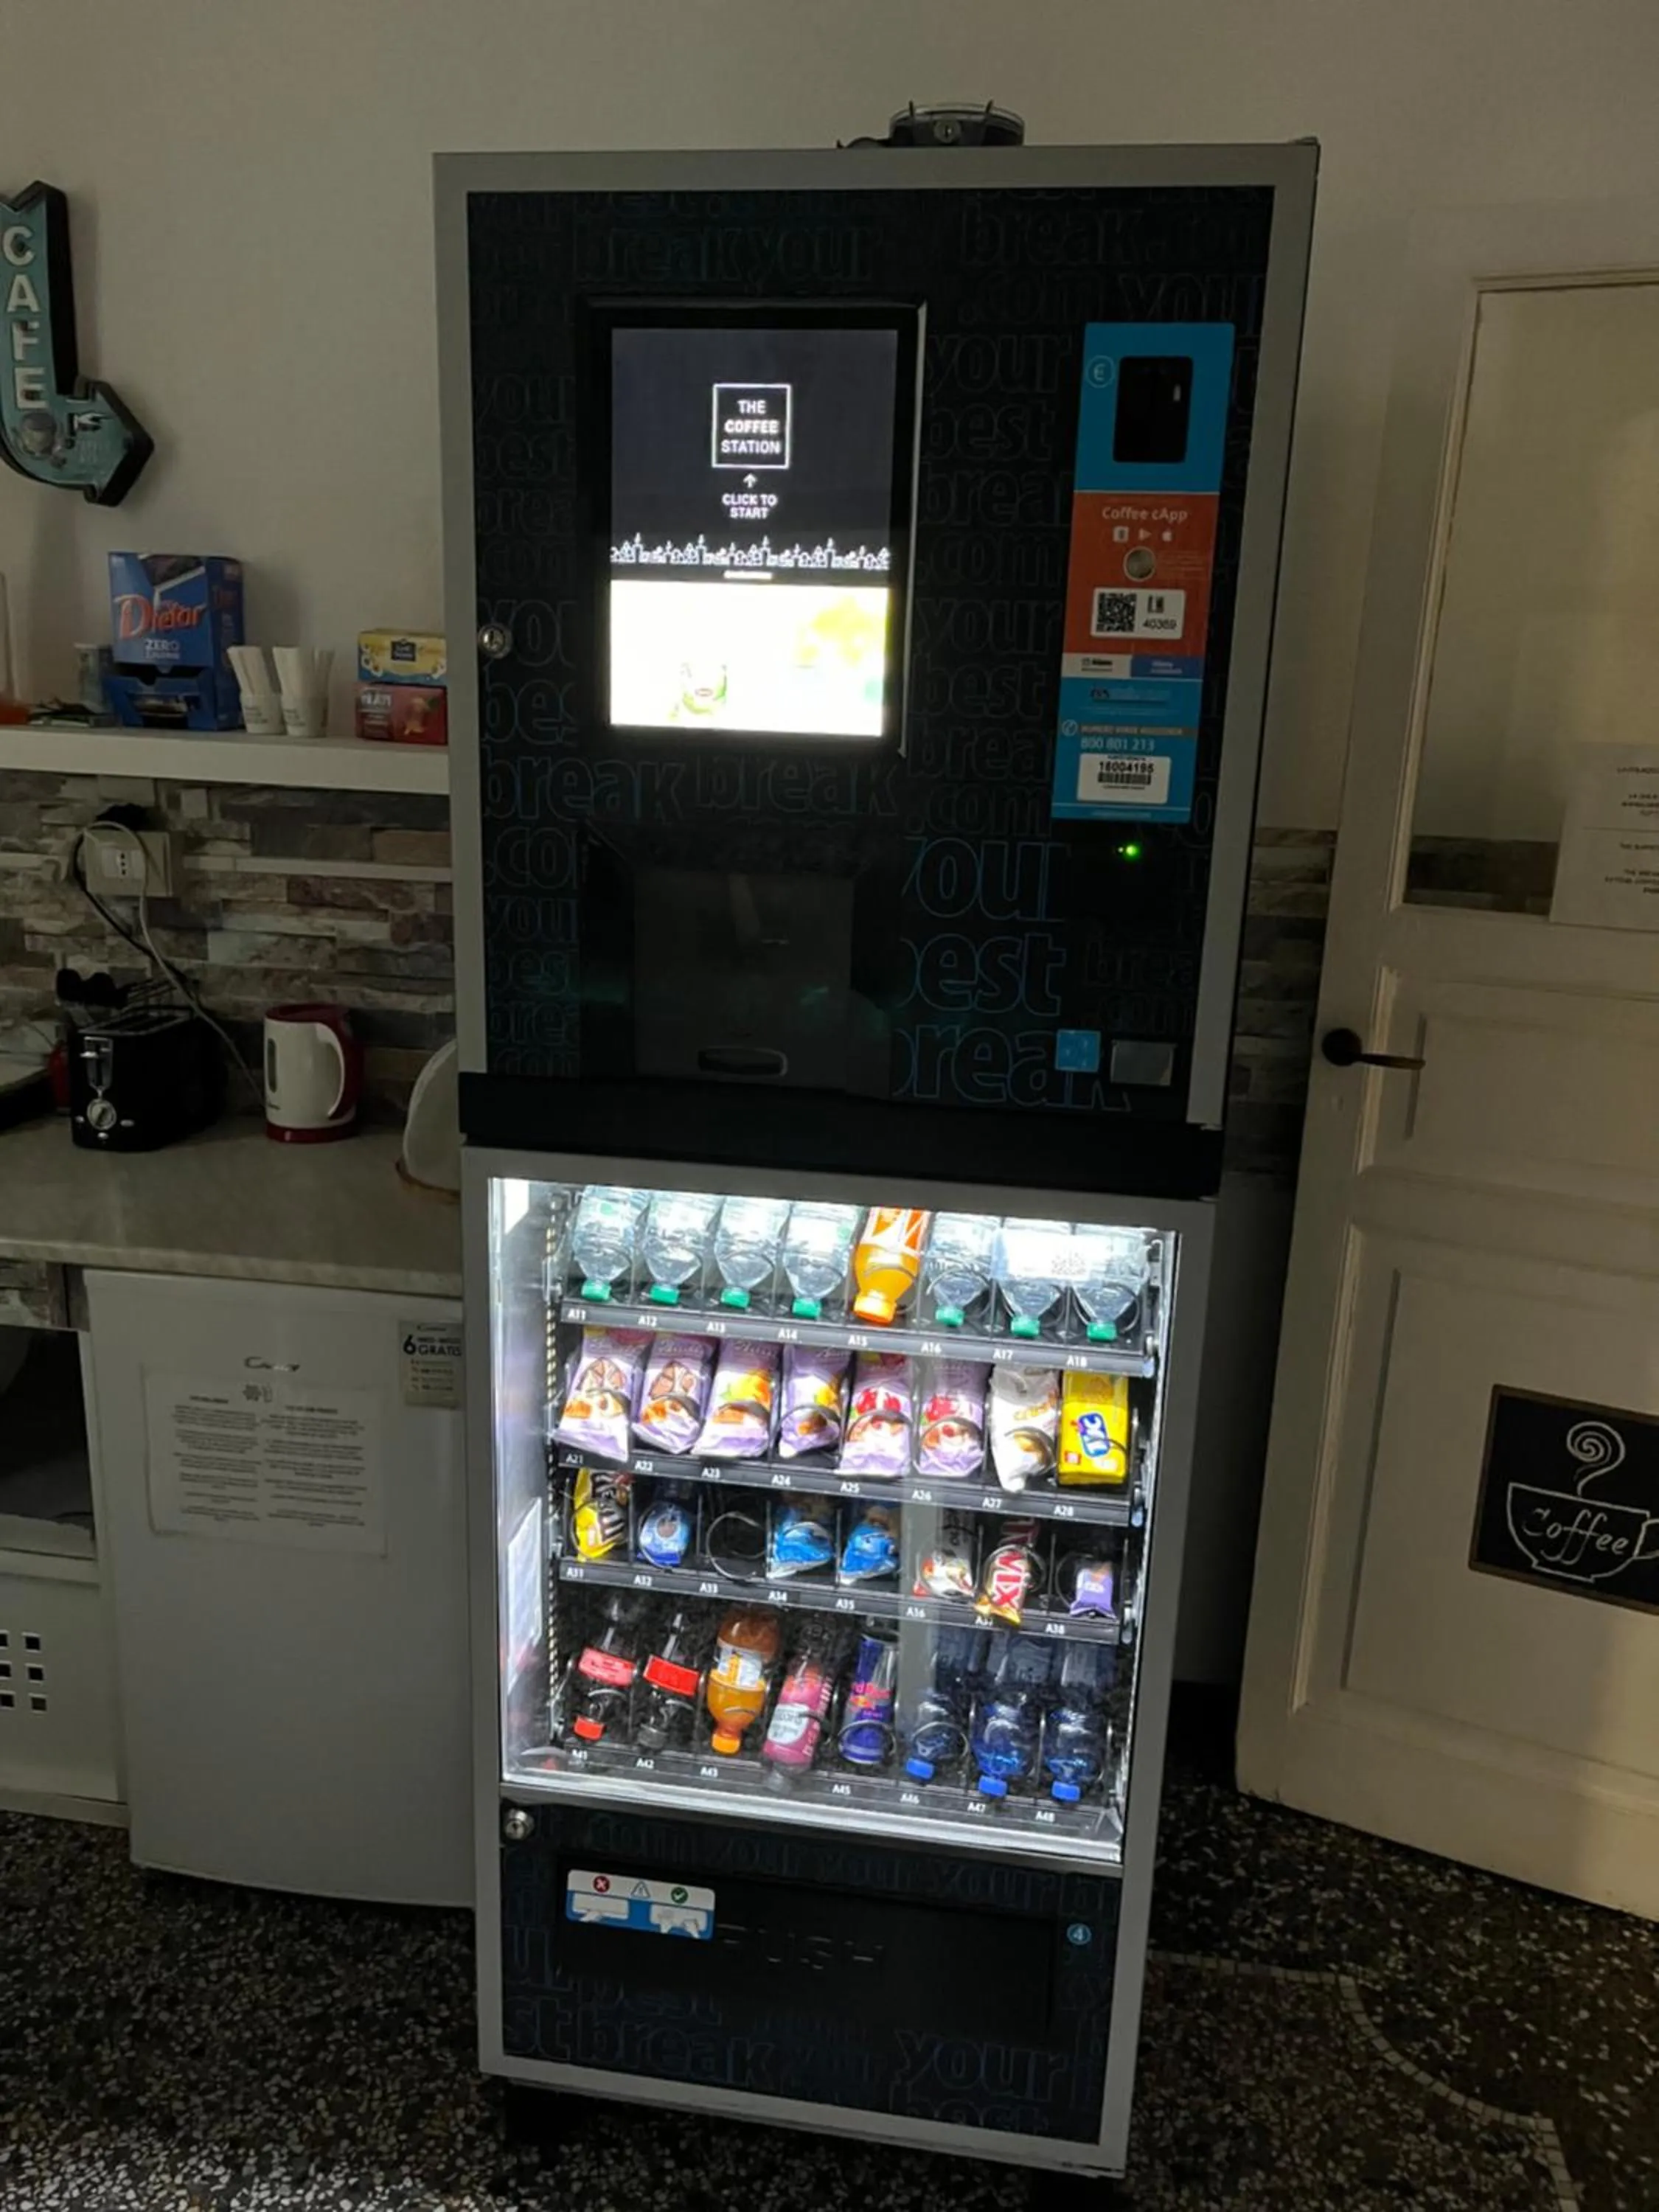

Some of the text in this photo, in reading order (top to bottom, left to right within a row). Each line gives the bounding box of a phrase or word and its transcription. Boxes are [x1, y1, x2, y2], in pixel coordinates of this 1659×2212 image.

[2, 225, 50, 411] CAFE
[737, 400, 766, 414] THE
[724, 420, 779, 434] COFFEE
[721, 440, 781, 454] STATION
[722, 493, 778, 507] CLICK TO
[729, 507, 769, 519] START
[567, 1308, 586, 1321] A11
[638, 1315, 657, 1327] A12
[778, 1327, 798, 1340] A14
[404, 1334, 416, 1354] 6
[848, 1335, 868, 1348] A15
[920, 1342, 942, 1354] A16
[992, 1348, 1014, 1360] A17
[1065, 1355, 1088, 1368] A18
[566, 1453, 584, 1464] A21
[634, 1460, 653, 1472] A22
[701, 1467, 720, 1478] A23
[771, 1474, 791, 1486] A24
[840, 1481, 860, 1494] A25
[911, 1489, 932, 1501] A26
[982, 1497, 1002, 1509] A27
[1522, 1506, 1630, 1566] Coffee
[633, 1574, 653, 1587] A32
[768, 1590, 787, 1602] A34
[835, 1598, 855, 1610] A35
[905, 1606, 926, 1618] A36
[636, 1757, 655, 1770] A42
[700, 1766, 719, 1778] A43
[967, 1801, 987, 1814] A47
